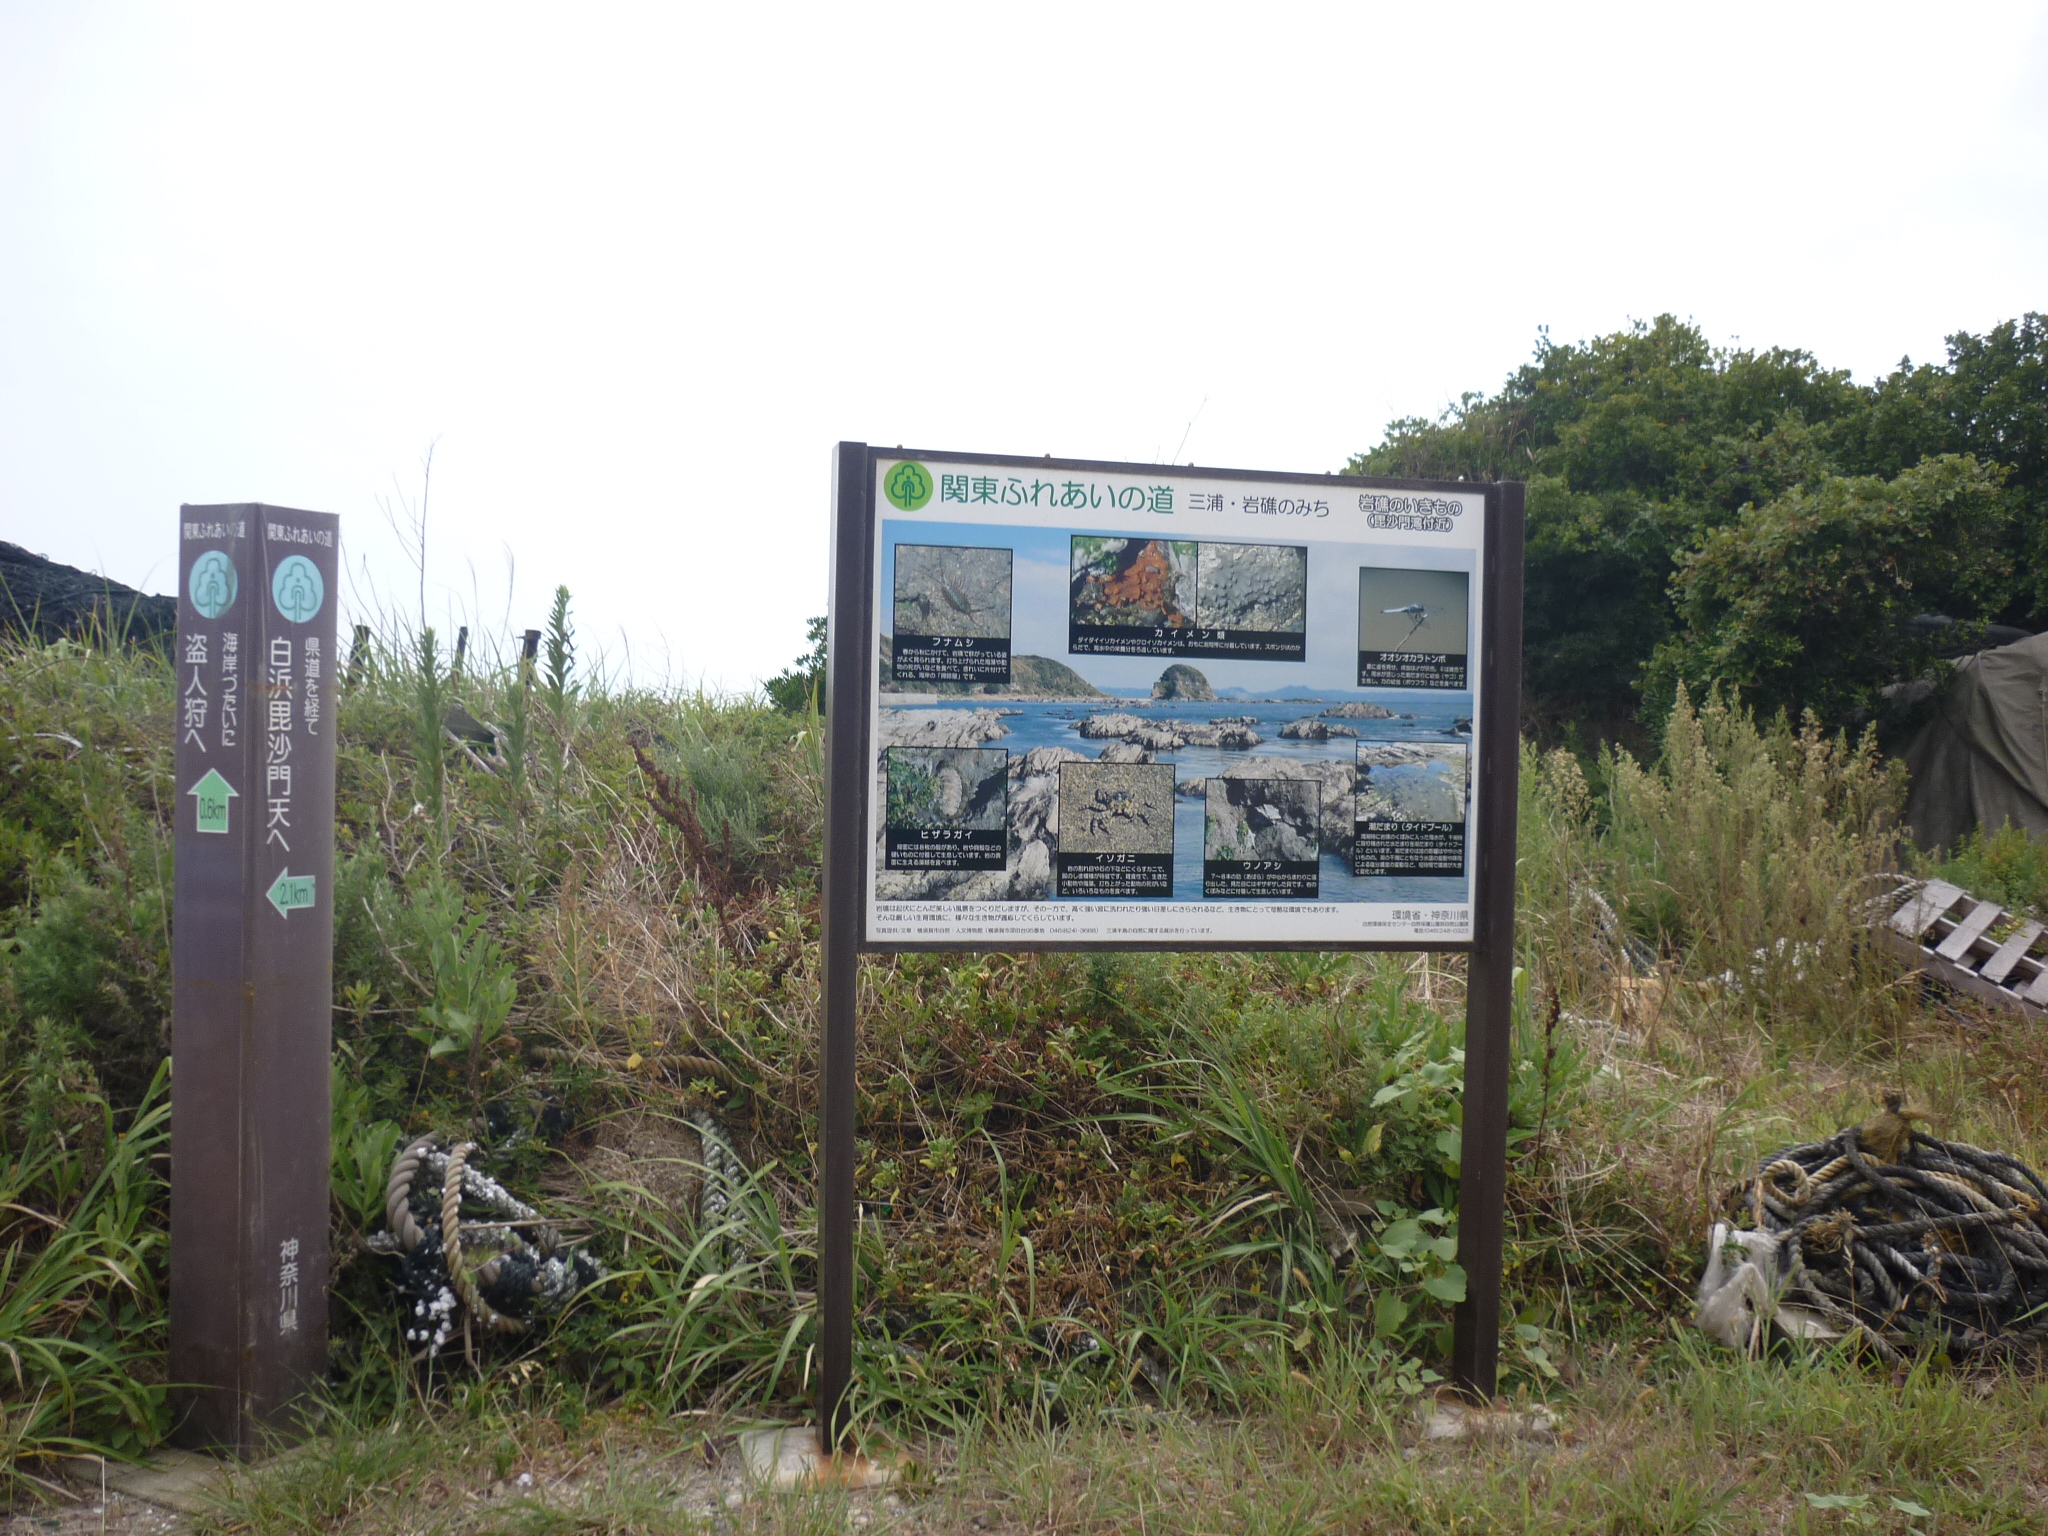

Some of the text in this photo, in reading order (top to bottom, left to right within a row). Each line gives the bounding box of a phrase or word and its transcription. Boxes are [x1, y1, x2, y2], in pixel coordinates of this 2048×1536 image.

[941, 474, 1174, 514] 関東ふれあいの道
[1188, 492, 1330, 518] 三浦・岩礁のみち
[1359, 494, 1463, 516] 岩礁のいきもの
[267, 523, 333, 548] 関東ふれあいの道
[932, 637, 974, 647] フナムシ
[1380, 653, 1446, 663] オオシオカラトンボ
[184, 633, 208, 752] 盗人狩へ
[222, 631, 238, 746] 海岸づたいに
[304, 637, 321, 735] 県道を経て
[267, 636, 292, 852] 白浜毘沙門天へ
[200, 797, 226, 820] 0.6km
[921, 830, 972, 839] ヒザラガイ
[1096, 854, 1135, 863] イソガニ
[1243, 862, 1281, 870] ウノアシ
[280, 883, 308, 905] 2.1km
[1392, 910, 1469, 920] 環境省・神奈川県
[279, 1237, 299, 1336] 神奈川県
